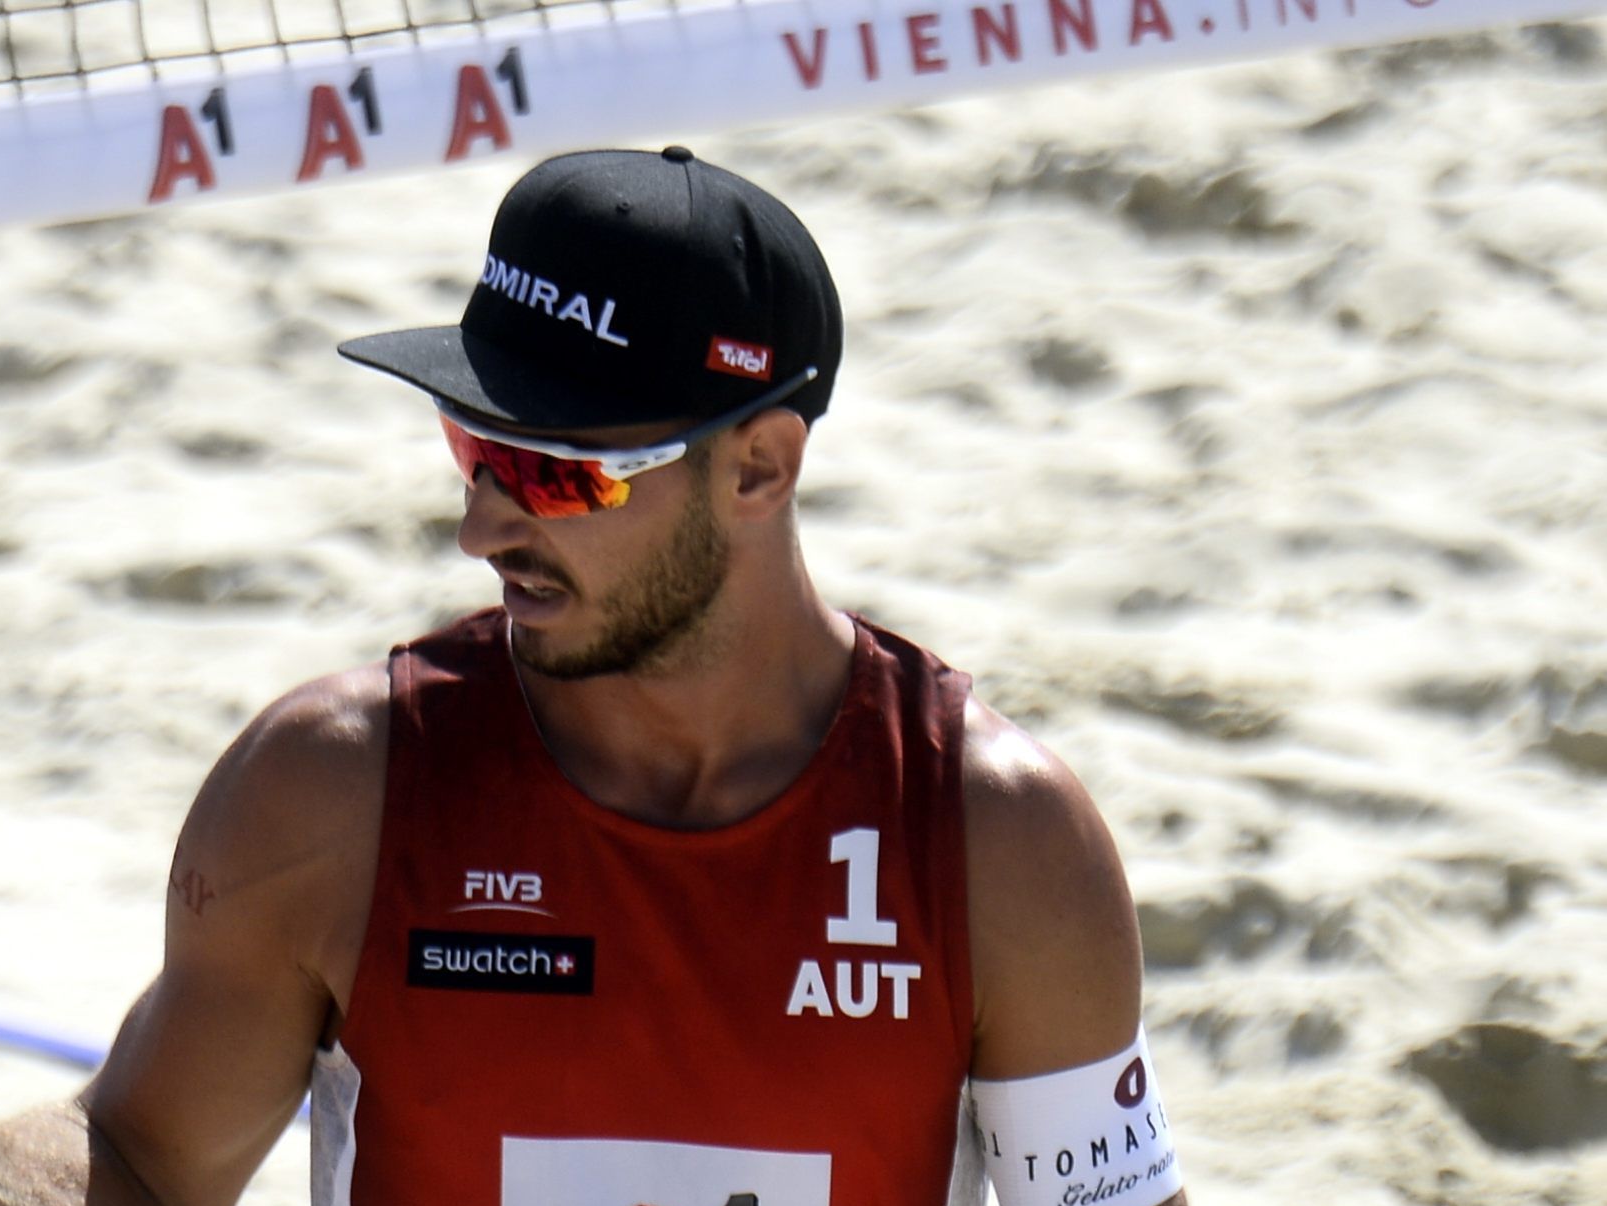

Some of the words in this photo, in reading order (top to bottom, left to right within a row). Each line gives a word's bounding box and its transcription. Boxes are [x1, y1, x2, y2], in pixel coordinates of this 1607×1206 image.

[148, 87, 235, 204] A1
[297, 66, 383, 182] A1
[445, 46, 530, 163] A1
[465, 870, 542, 902] FIVB
[826, 827, 898, 946] 1
[422, 945, 551, 976] swatch
[786, 960, 922, 1019] AUT
